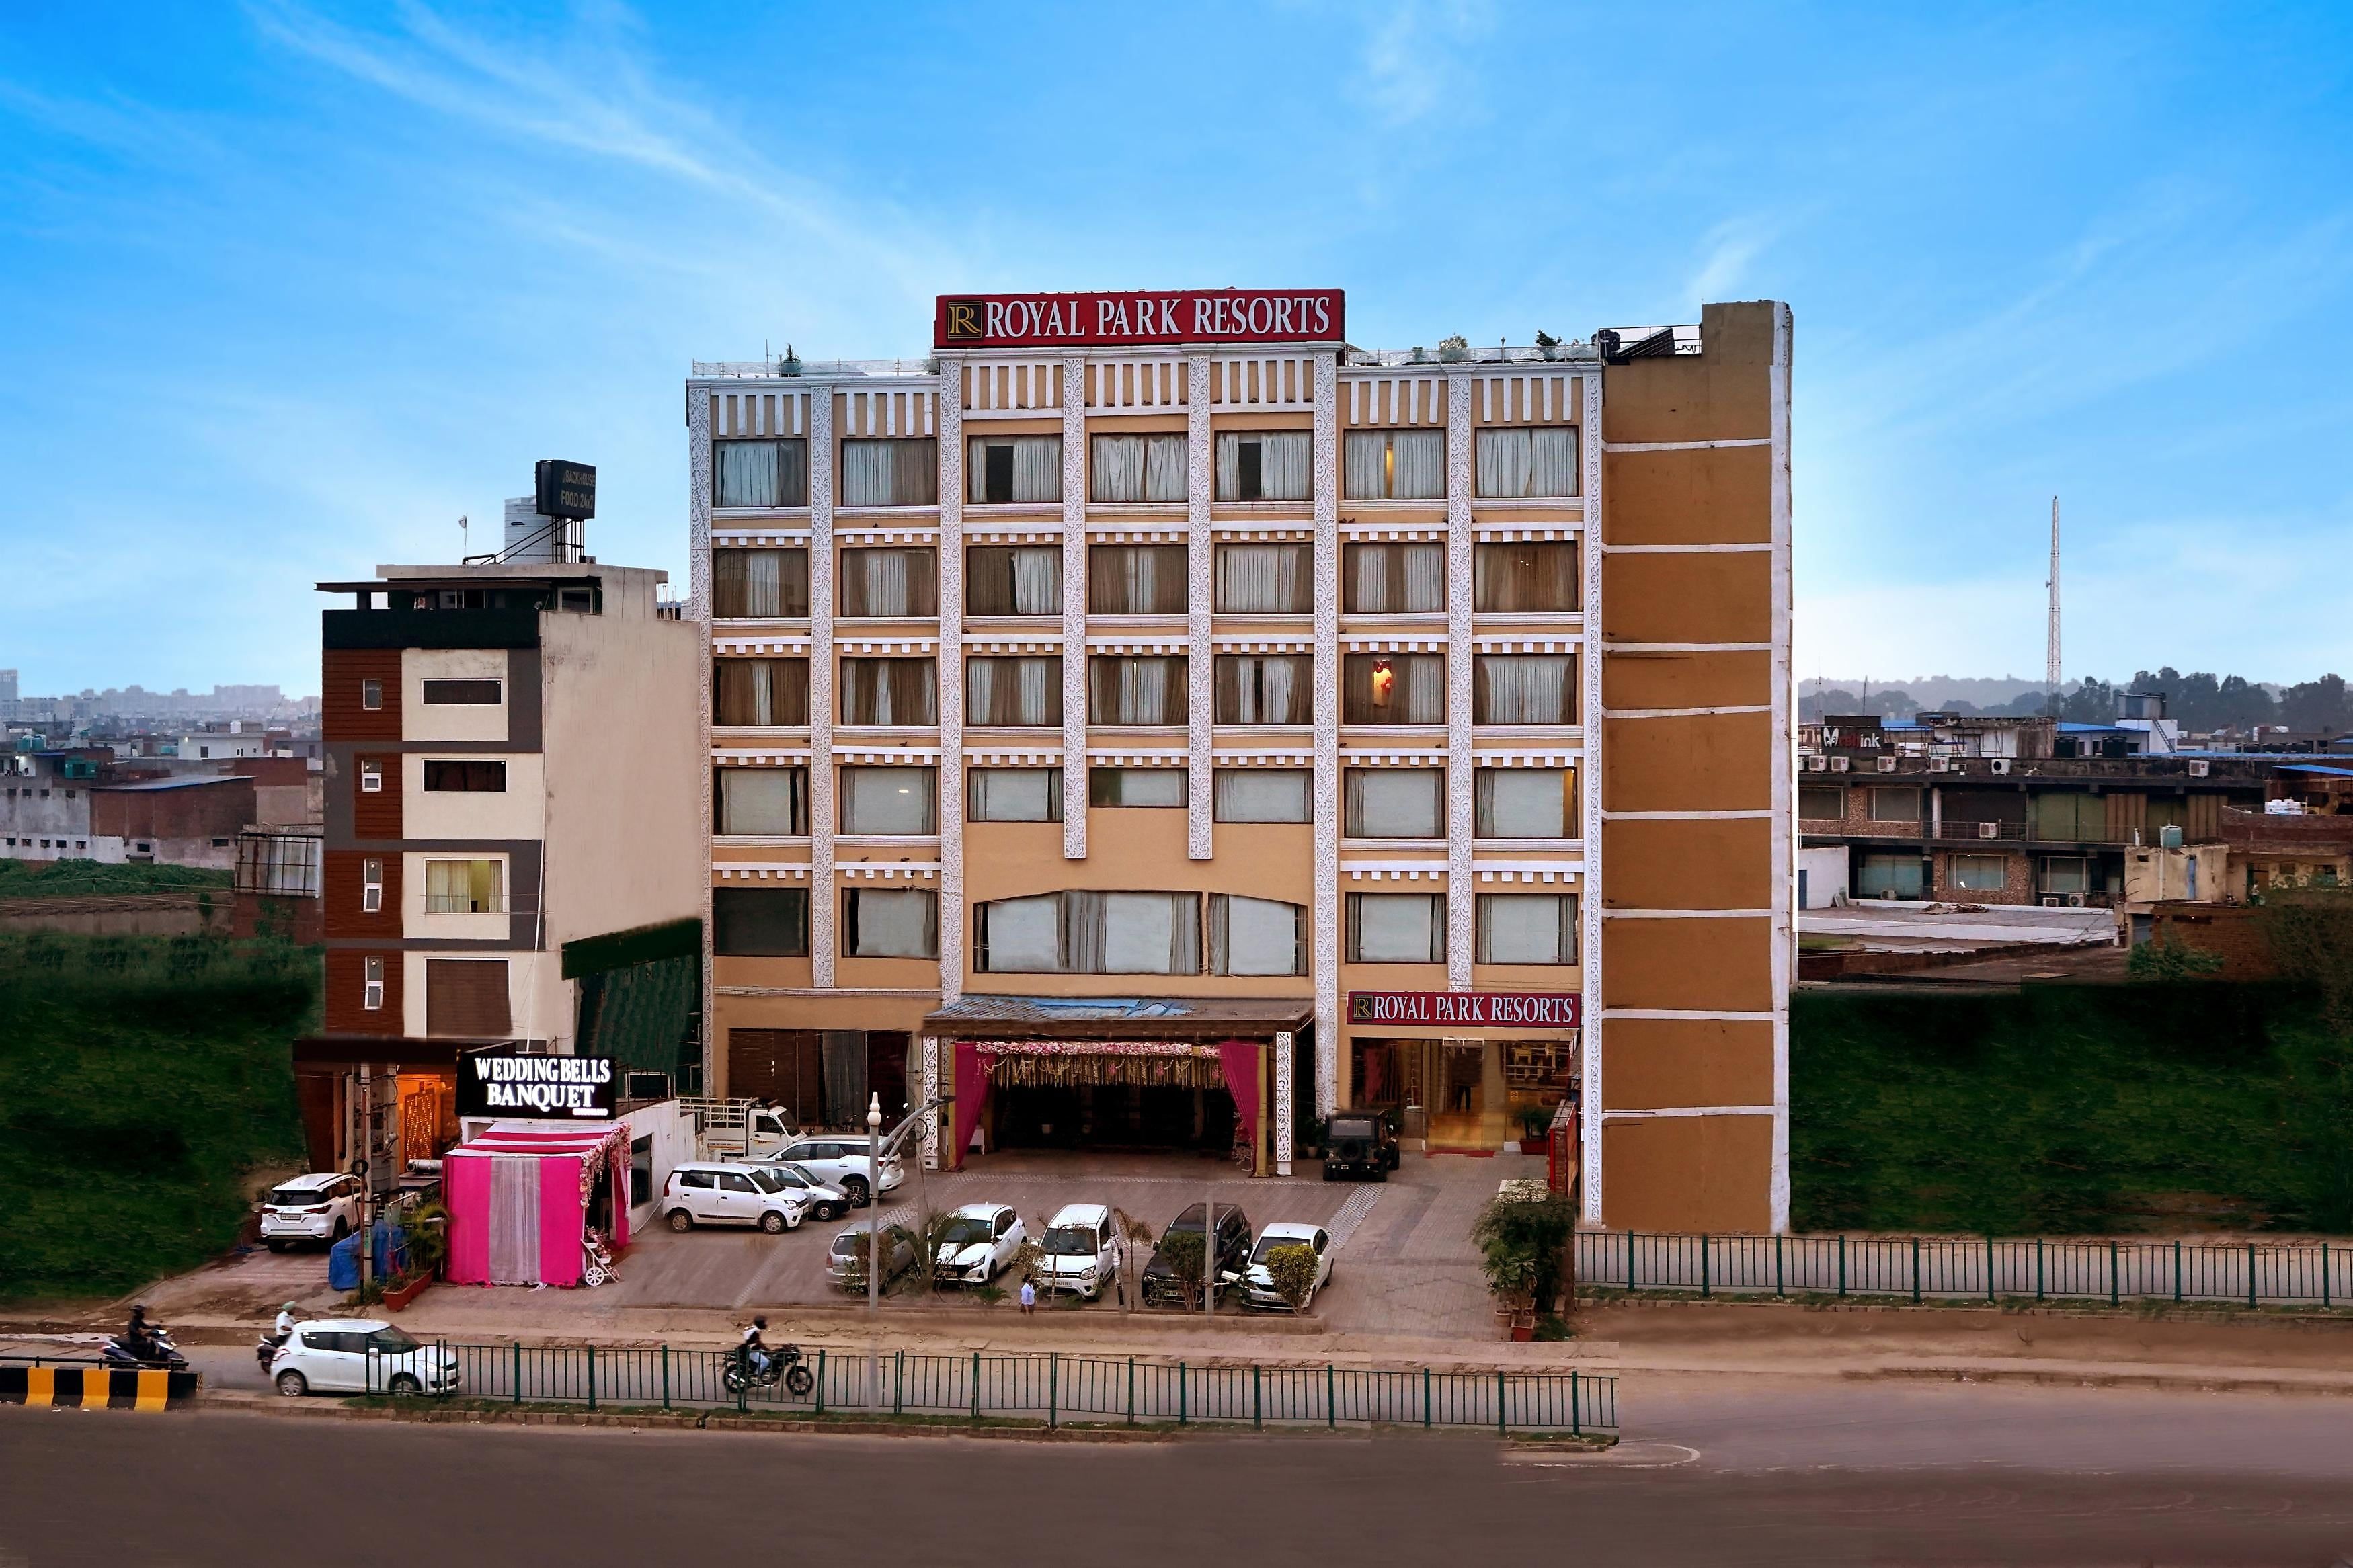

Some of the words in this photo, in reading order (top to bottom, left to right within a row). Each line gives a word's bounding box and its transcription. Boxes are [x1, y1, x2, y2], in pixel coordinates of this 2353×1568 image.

[985, 301, 1085, 337] ROYAL
[1096, 299, 1182, 335] PARK
[1192, 297, 1330, 335] RESORTS
[561, 490, 578, 507] FOOD
[1373, 995, 1429, 1020] ROYAL
[1435, 997, 1485, 1020] PARK
[1490, 997, 1573, 1023] RESORTS
[474, 1057, 559, 1081] WEDDING
[559, 1059, 610, 1083] BELLS
[487, 1083, 595, 1112] BANQUET
